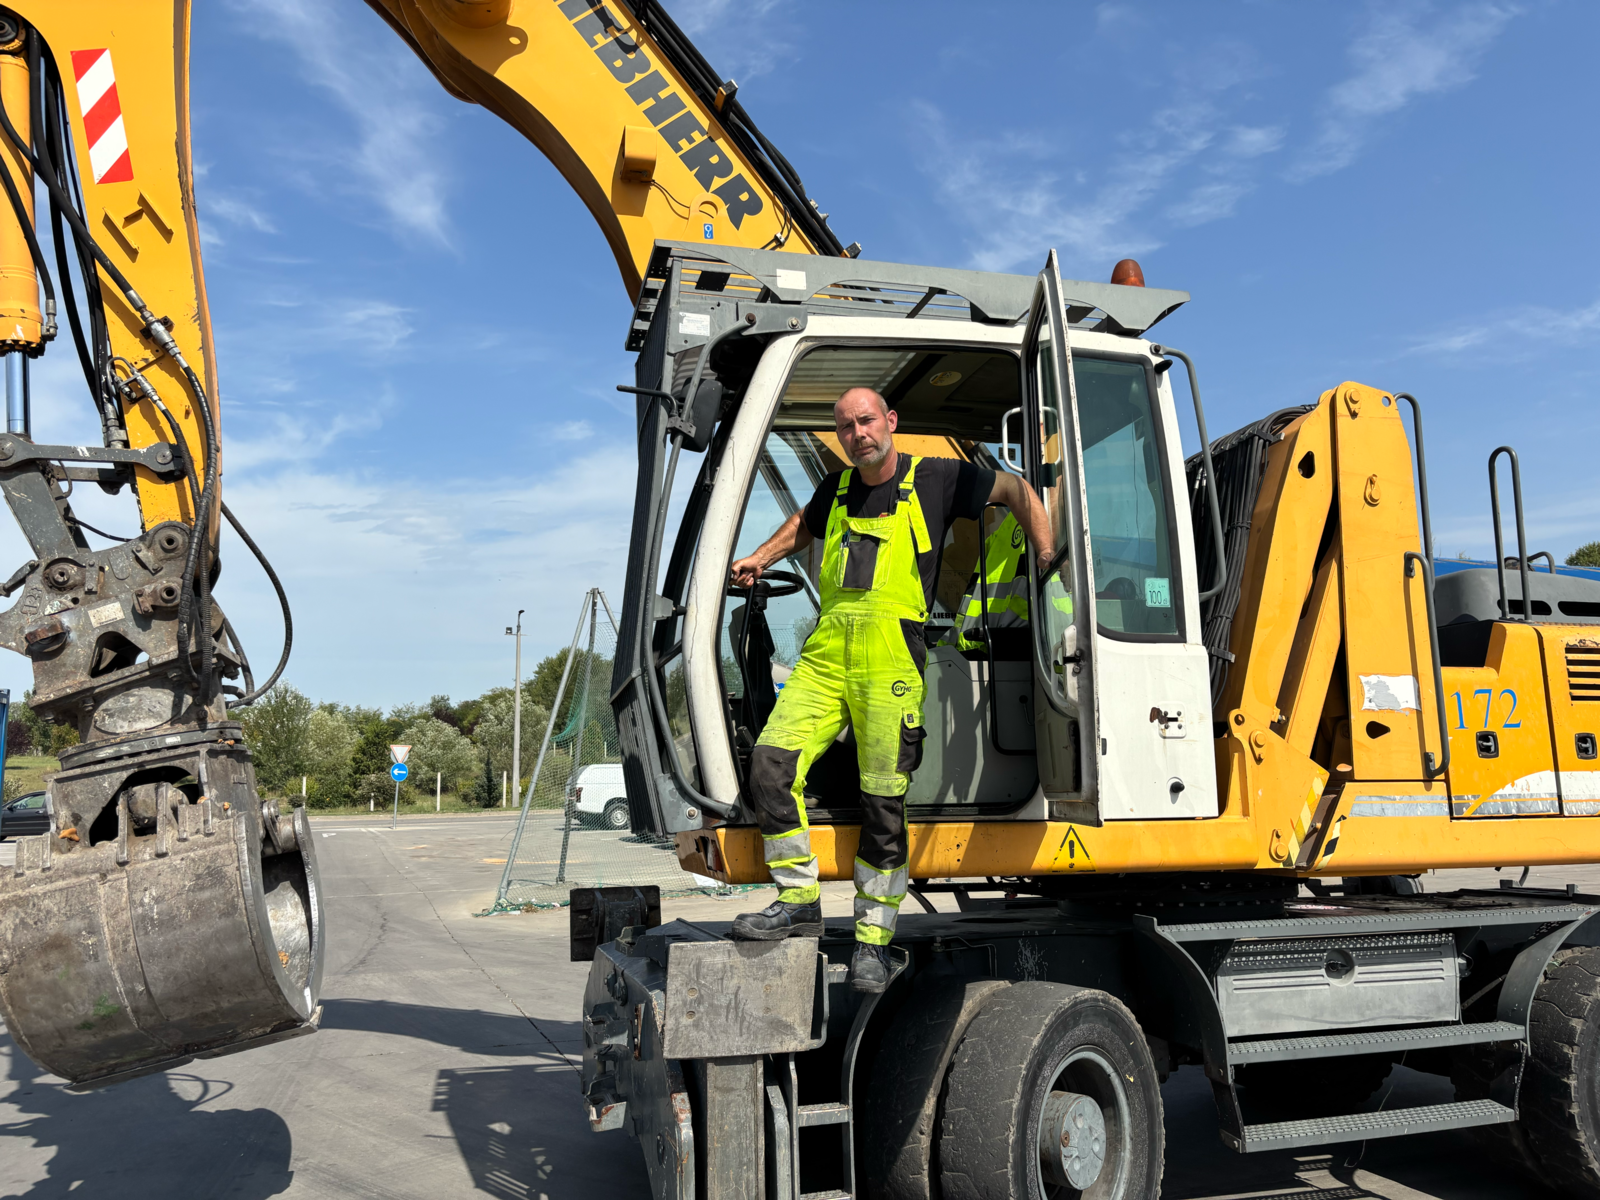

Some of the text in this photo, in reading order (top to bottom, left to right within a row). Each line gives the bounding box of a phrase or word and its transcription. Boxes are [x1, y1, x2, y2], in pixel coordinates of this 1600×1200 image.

[553, 0, 763, 231] IEBHERR
[1149, 590, 1162, 604] 100
[1450, 688, 1522, 730] 172
